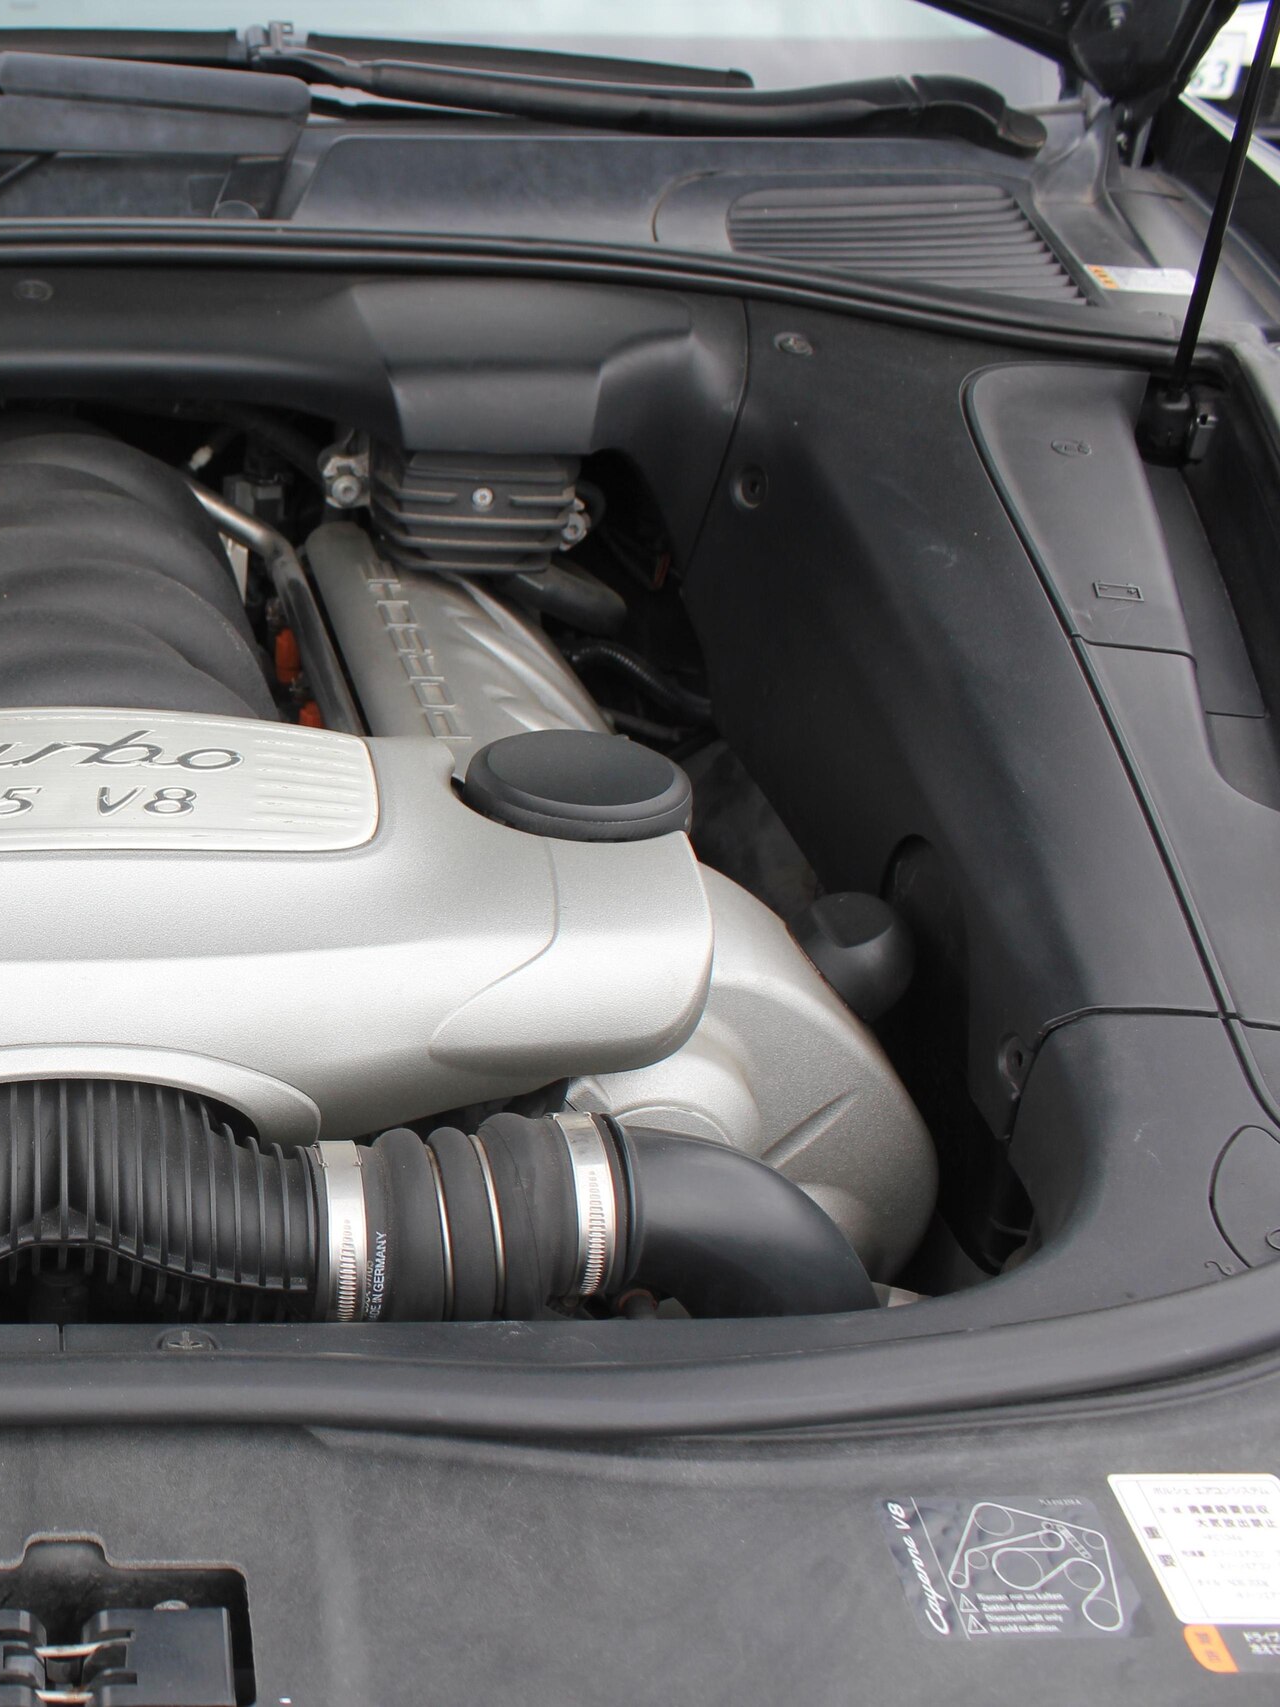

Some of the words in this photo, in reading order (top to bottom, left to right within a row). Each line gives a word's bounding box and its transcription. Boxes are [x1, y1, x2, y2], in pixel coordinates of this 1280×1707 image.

[97, 784, 198, 816] V8
[373, 1231, 387, 1292] GERMANY
[887, 1502, 911, 1530] V8
[903, 1536, 950, 1635] Cayenne
